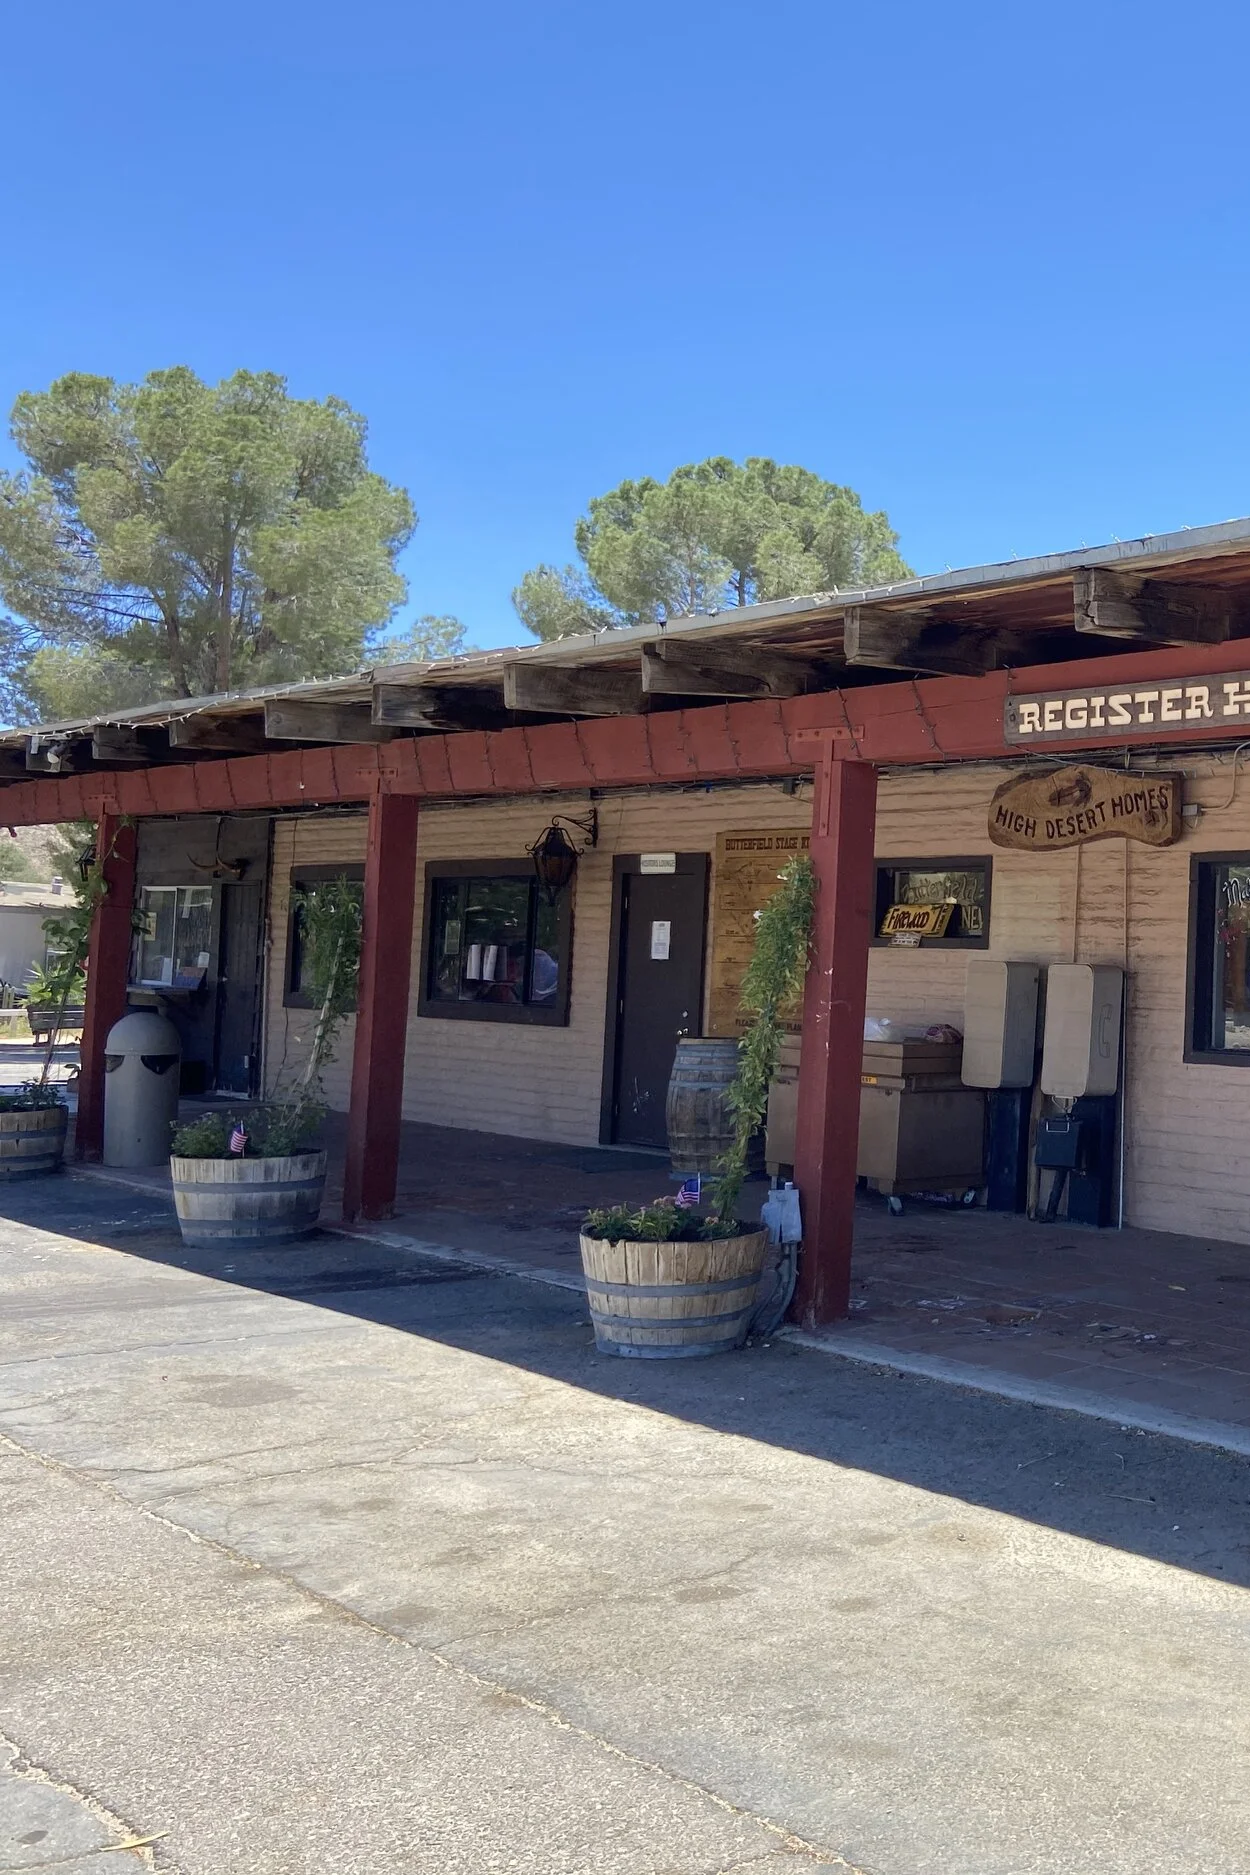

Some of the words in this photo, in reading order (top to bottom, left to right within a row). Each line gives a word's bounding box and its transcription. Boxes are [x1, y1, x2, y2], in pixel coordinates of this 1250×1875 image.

[1018, 685, 1214, 735] REGISTER
[995, 804, 1037, 839] HIGH
[1045, 801, 1107, 840] DESERT
[1111, 786, 1170, 819] HOMES
[725, 838, 773, 851] BUTTERFIELD
[776, 837, 798, 850] STAGE
[887, 908, 931, 931] FIREWOOD
